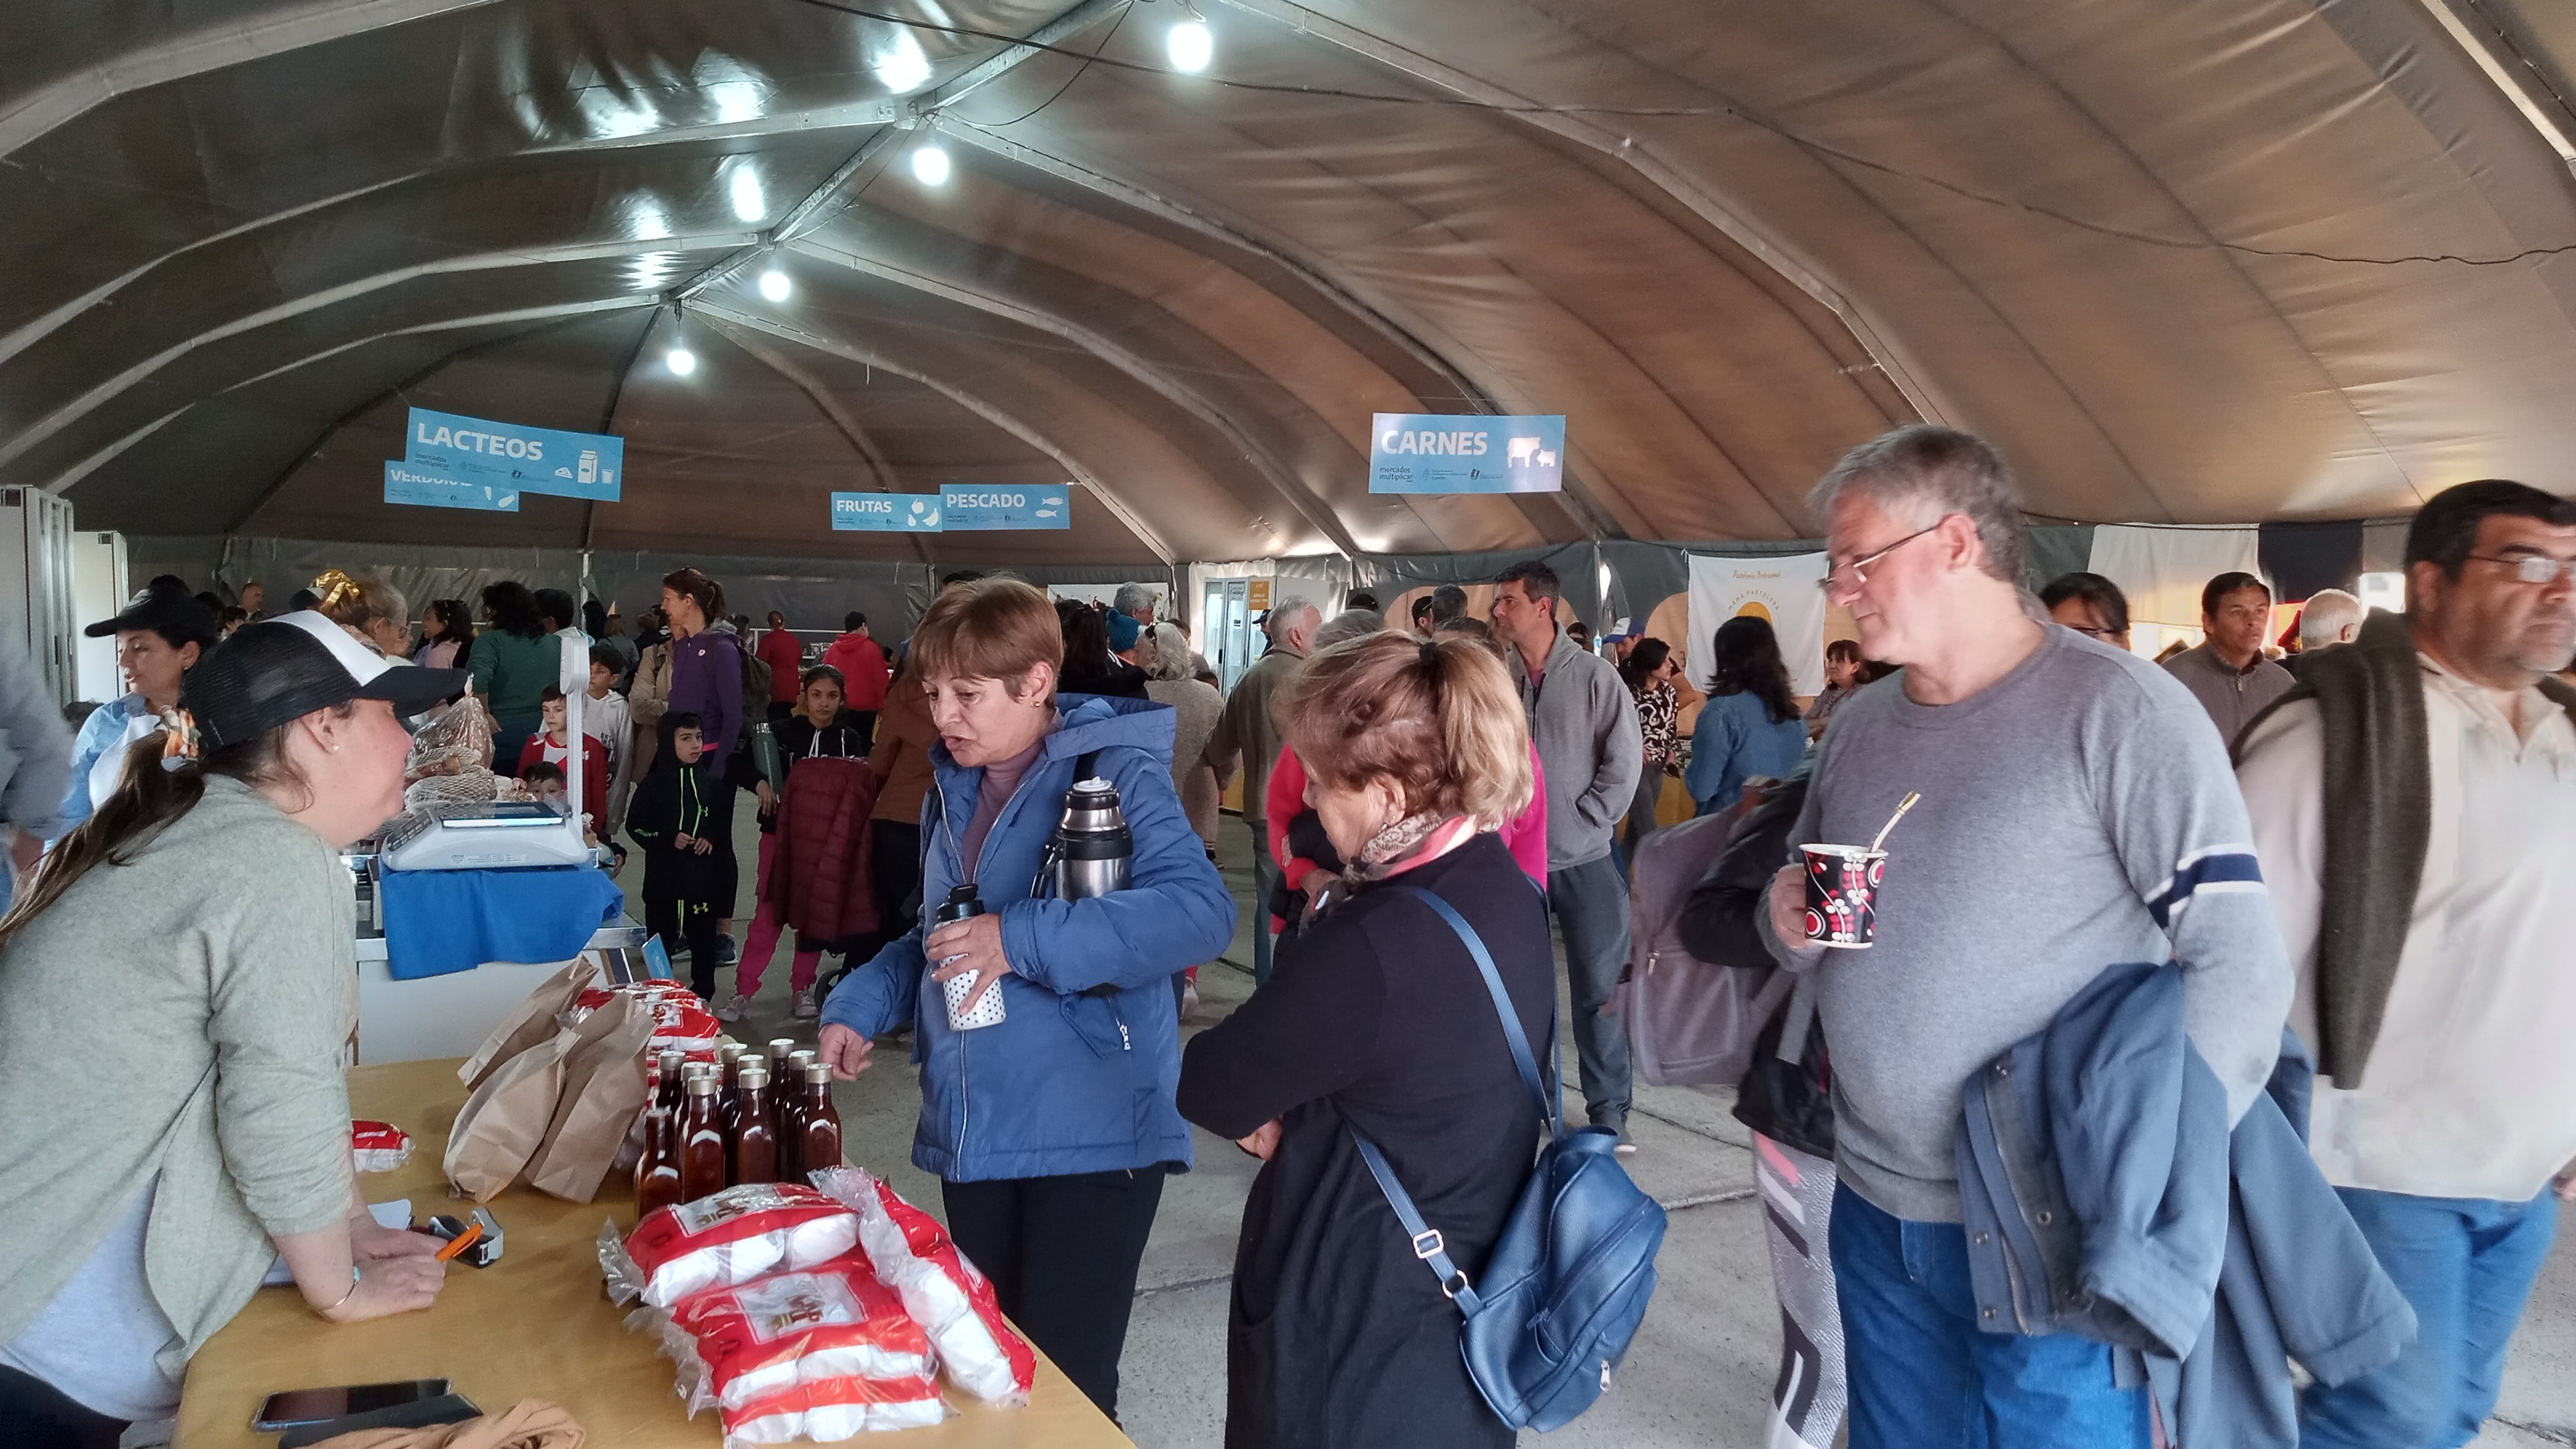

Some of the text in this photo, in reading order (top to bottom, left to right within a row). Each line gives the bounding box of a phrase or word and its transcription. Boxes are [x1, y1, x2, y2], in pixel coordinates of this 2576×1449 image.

[417, 423, 543, 460] LACTEOS
[1381, 430, 1488, 455] CARNES
[1379, 473, 1413, 482] multiplicar
[836, 500, 892, 513] FRUTAS
[946, 494, 1026, 508] PESCADO
[1746, 589, 1779, 611] PASTELERA
